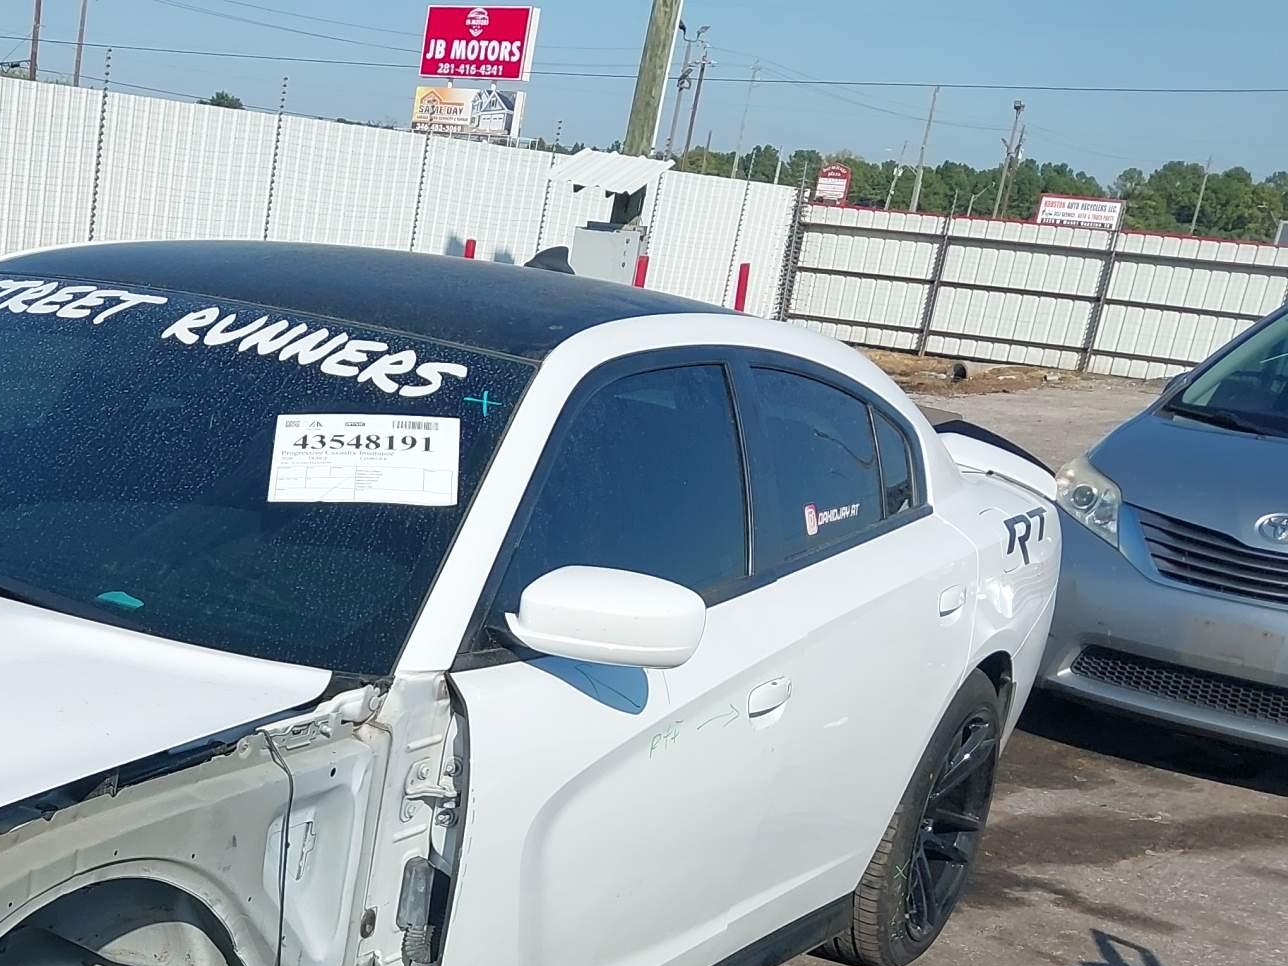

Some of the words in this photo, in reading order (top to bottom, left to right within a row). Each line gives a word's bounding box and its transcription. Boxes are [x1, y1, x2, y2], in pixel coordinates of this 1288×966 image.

[426, 39, 446, 60] JB
[450, 39, 521, 62] MOTORS
[436, 63, 504, 76] 281-416-4341
[447, 106, 464, 116] DAY
[161, 306, 468, 398] RUNNERS
[293, 434, 433, 453] 43548191
[1003, 506, 1047, 566] RT
